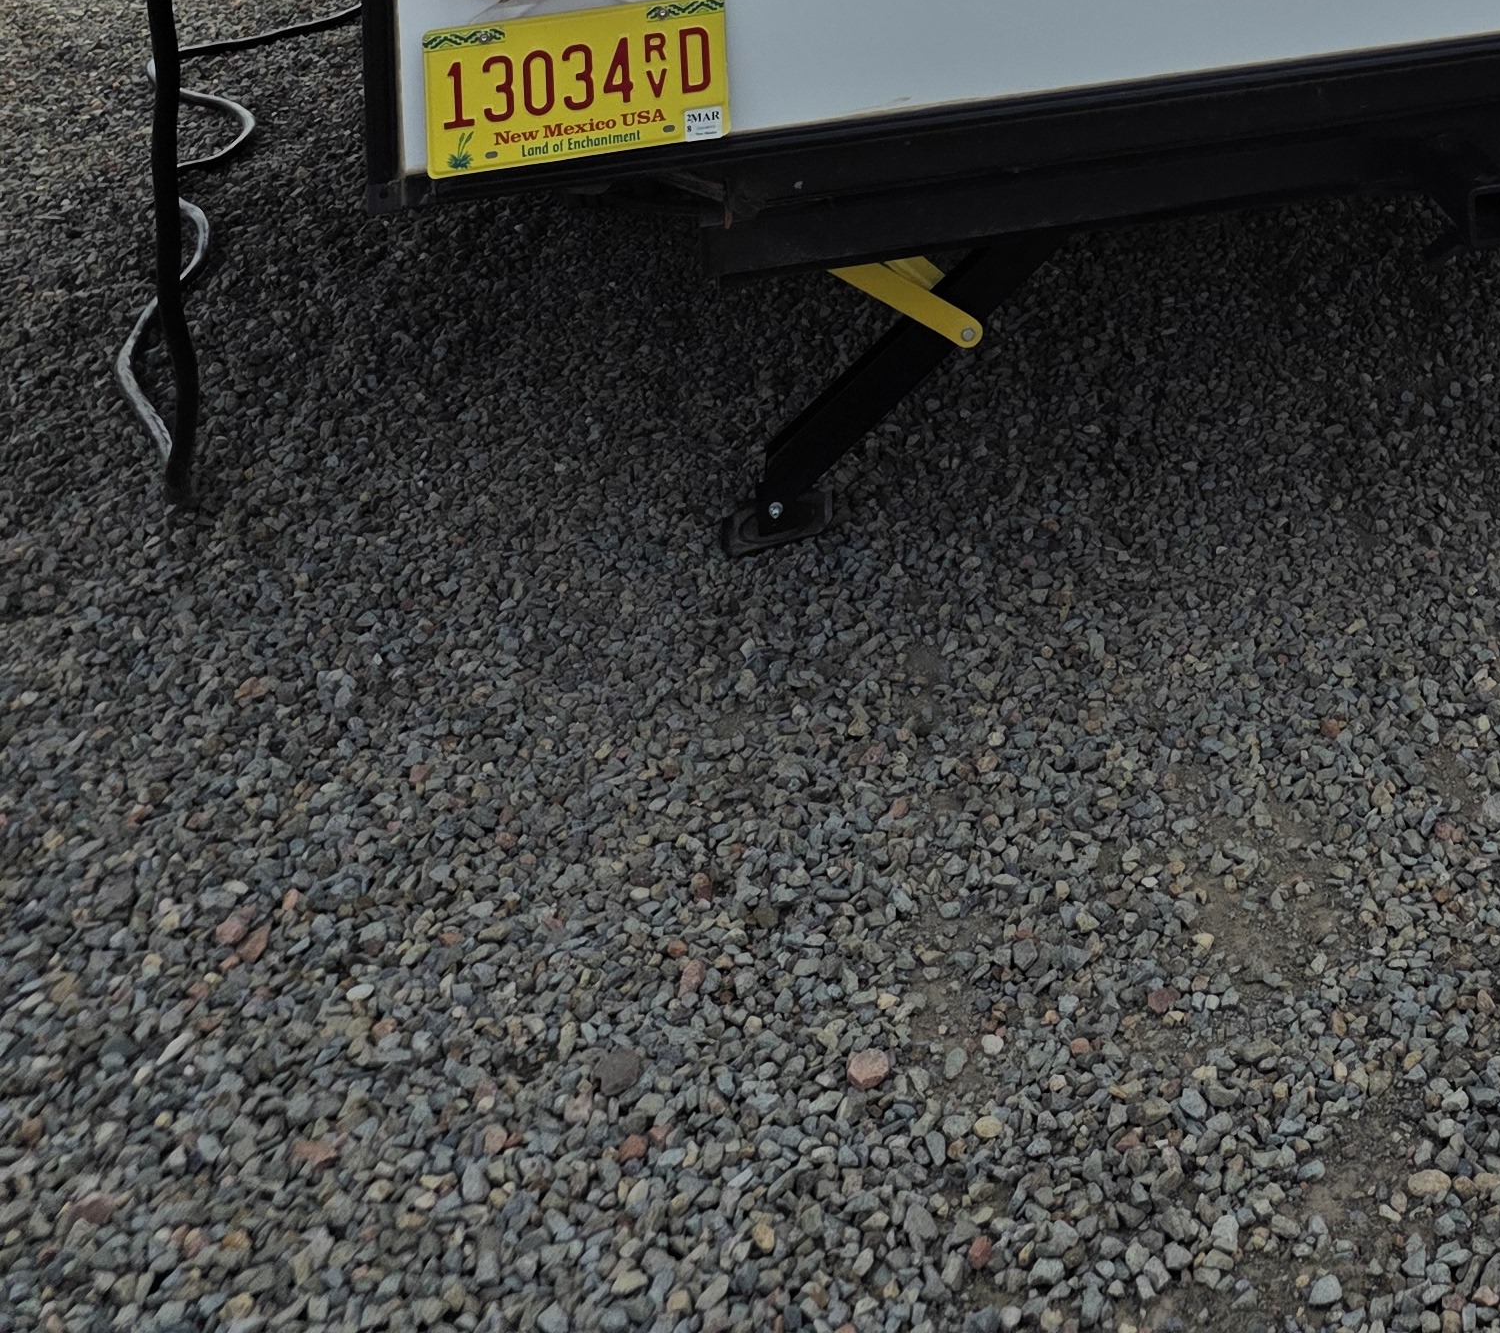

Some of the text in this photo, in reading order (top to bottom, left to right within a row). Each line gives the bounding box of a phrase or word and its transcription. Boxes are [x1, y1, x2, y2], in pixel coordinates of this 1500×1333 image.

[493, 108, 667, 146] New Mexico USA
[691, 110, 720, 123] MAR
[521, 129, 641, 158] Land of Enchantment
